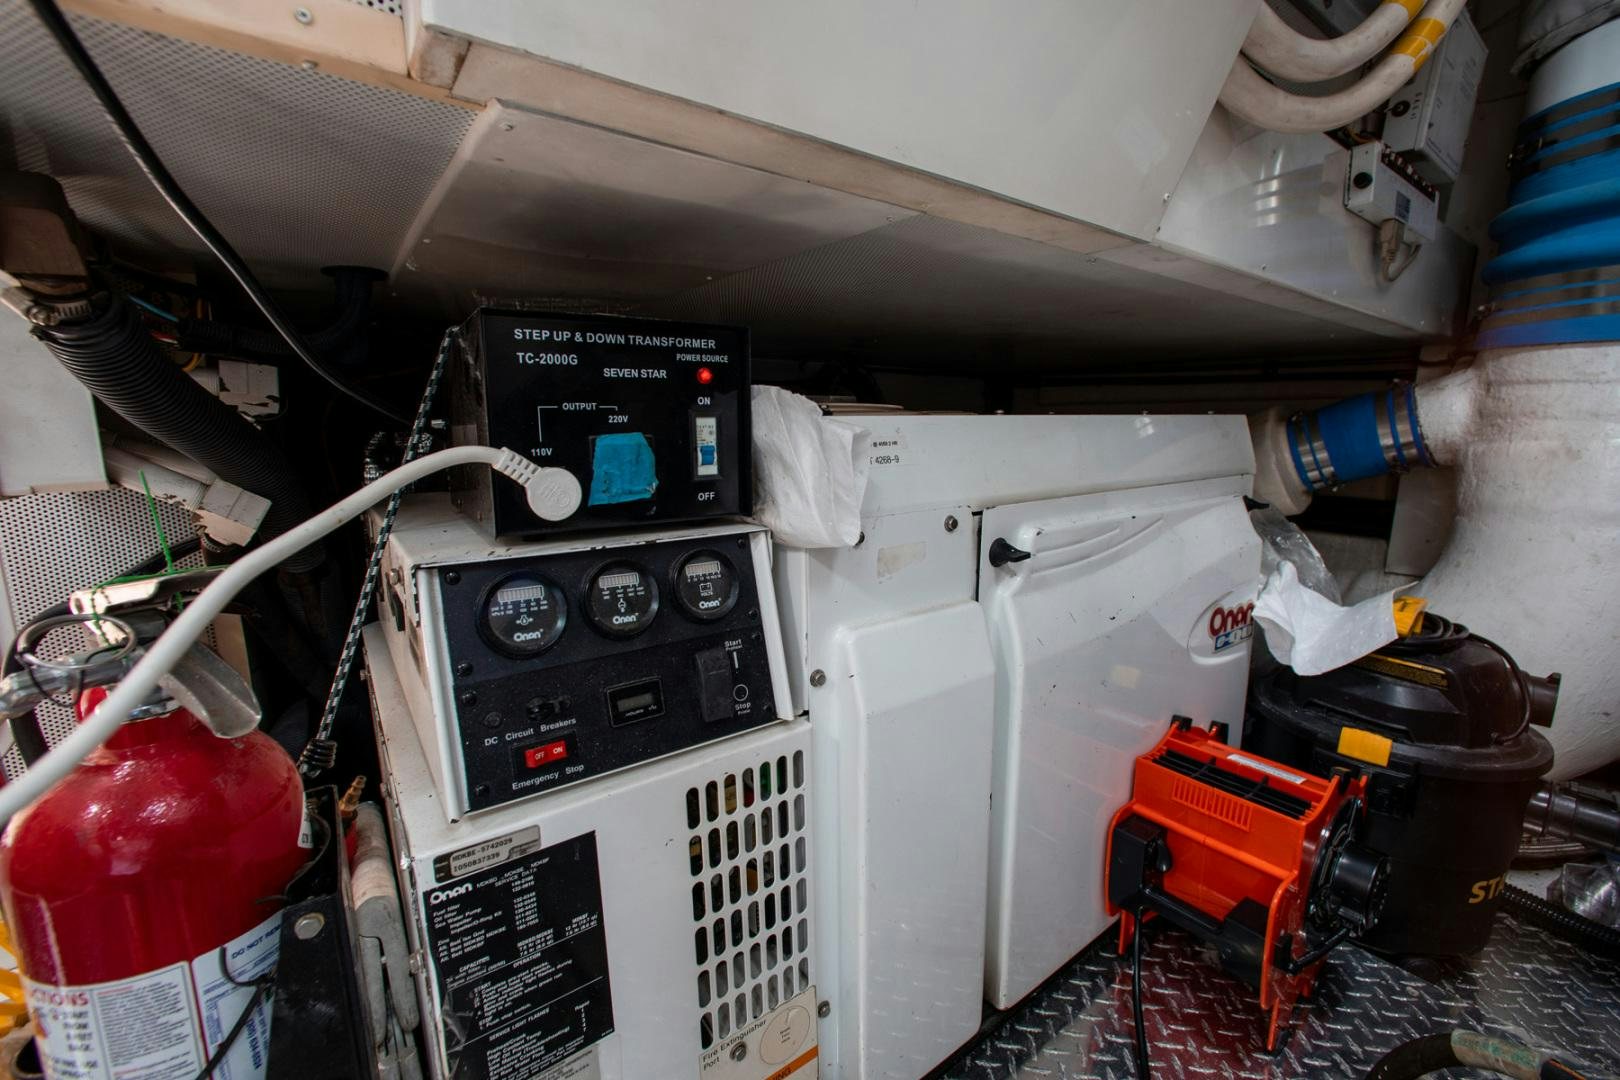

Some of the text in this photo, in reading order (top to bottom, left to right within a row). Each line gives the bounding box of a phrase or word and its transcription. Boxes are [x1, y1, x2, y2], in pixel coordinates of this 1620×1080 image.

[514, 328, 716, 349] STEP UP & DOWN TRANSFORMER
[516, 352, 578, 365] TC-2000G
[676, 353, 728, 363] POWER SOURCE
[603, 368, 667, 379] SEVEN STAR
[697, 396, 711, 405] ON
[562, 402, 597, 411] OUTPUT
[608, 415, 629, 424] 220V
[531, 447, 552, 457] 110V
[697, 491, 715, 501] OFF
[698, 599, 720, 609] Onan
[612, 614, 636, 625] Onan
[513, 630, 541, 642] Onan
[724, 638, 742, 648] Start
[735, 701, 751, 711] Stop
[484, 717, 577, 746] DC Circuit Breakers
[534, 746, 563, 760] OFF ON
[512, 764, 584, 790] Emergency Stop
[430, 882, 473, 906] Onan
[231, 948, 245, 960] DO
[246, 936, 263, 952] NOT
[702, 1049, 718, 1061] Fire
[720, 1019, 766, 1051] Extinguisher
[703, 1056, 720, 1071] Port
